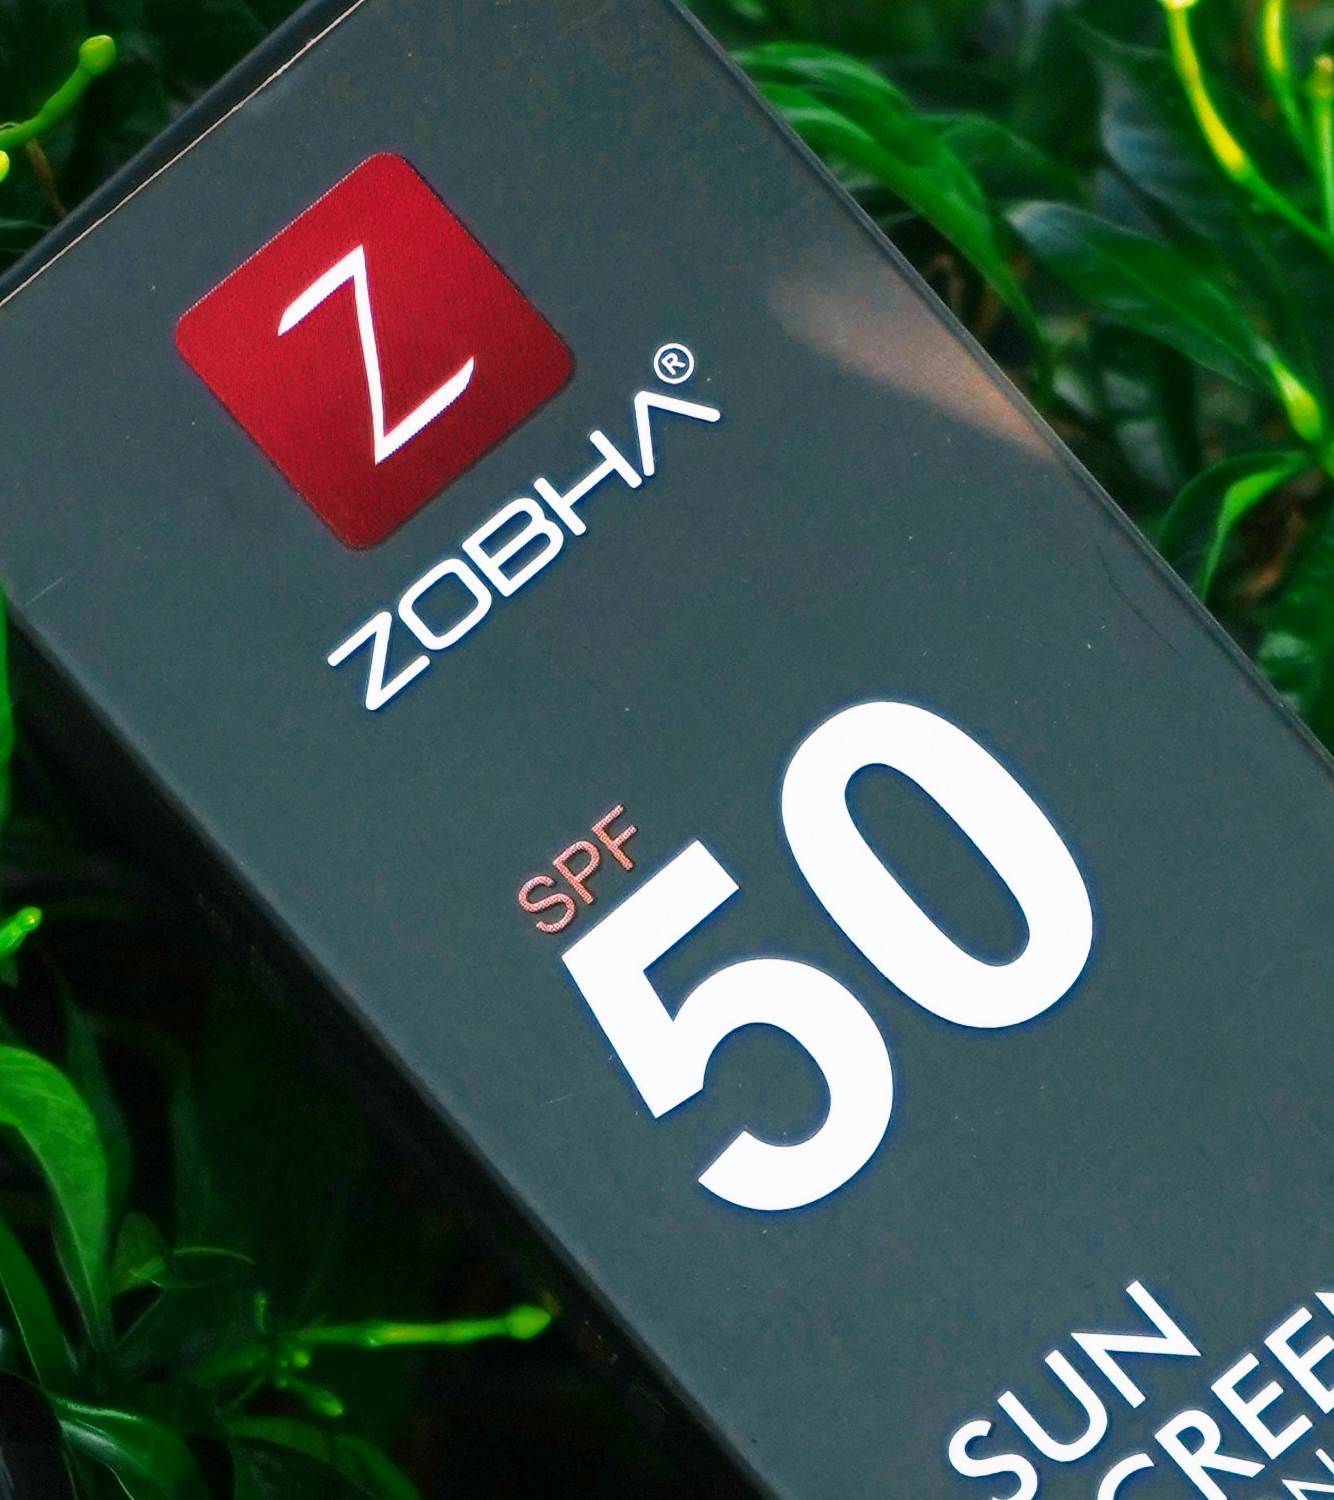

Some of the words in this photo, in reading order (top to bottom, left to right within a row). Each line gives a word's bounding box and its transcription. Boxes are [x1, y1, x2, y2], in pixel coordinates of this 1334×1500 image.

[278, 244, 475, 466] Z
[517, 804, 637, 935] SPF
[561, 701, 1094, 1211] 50
